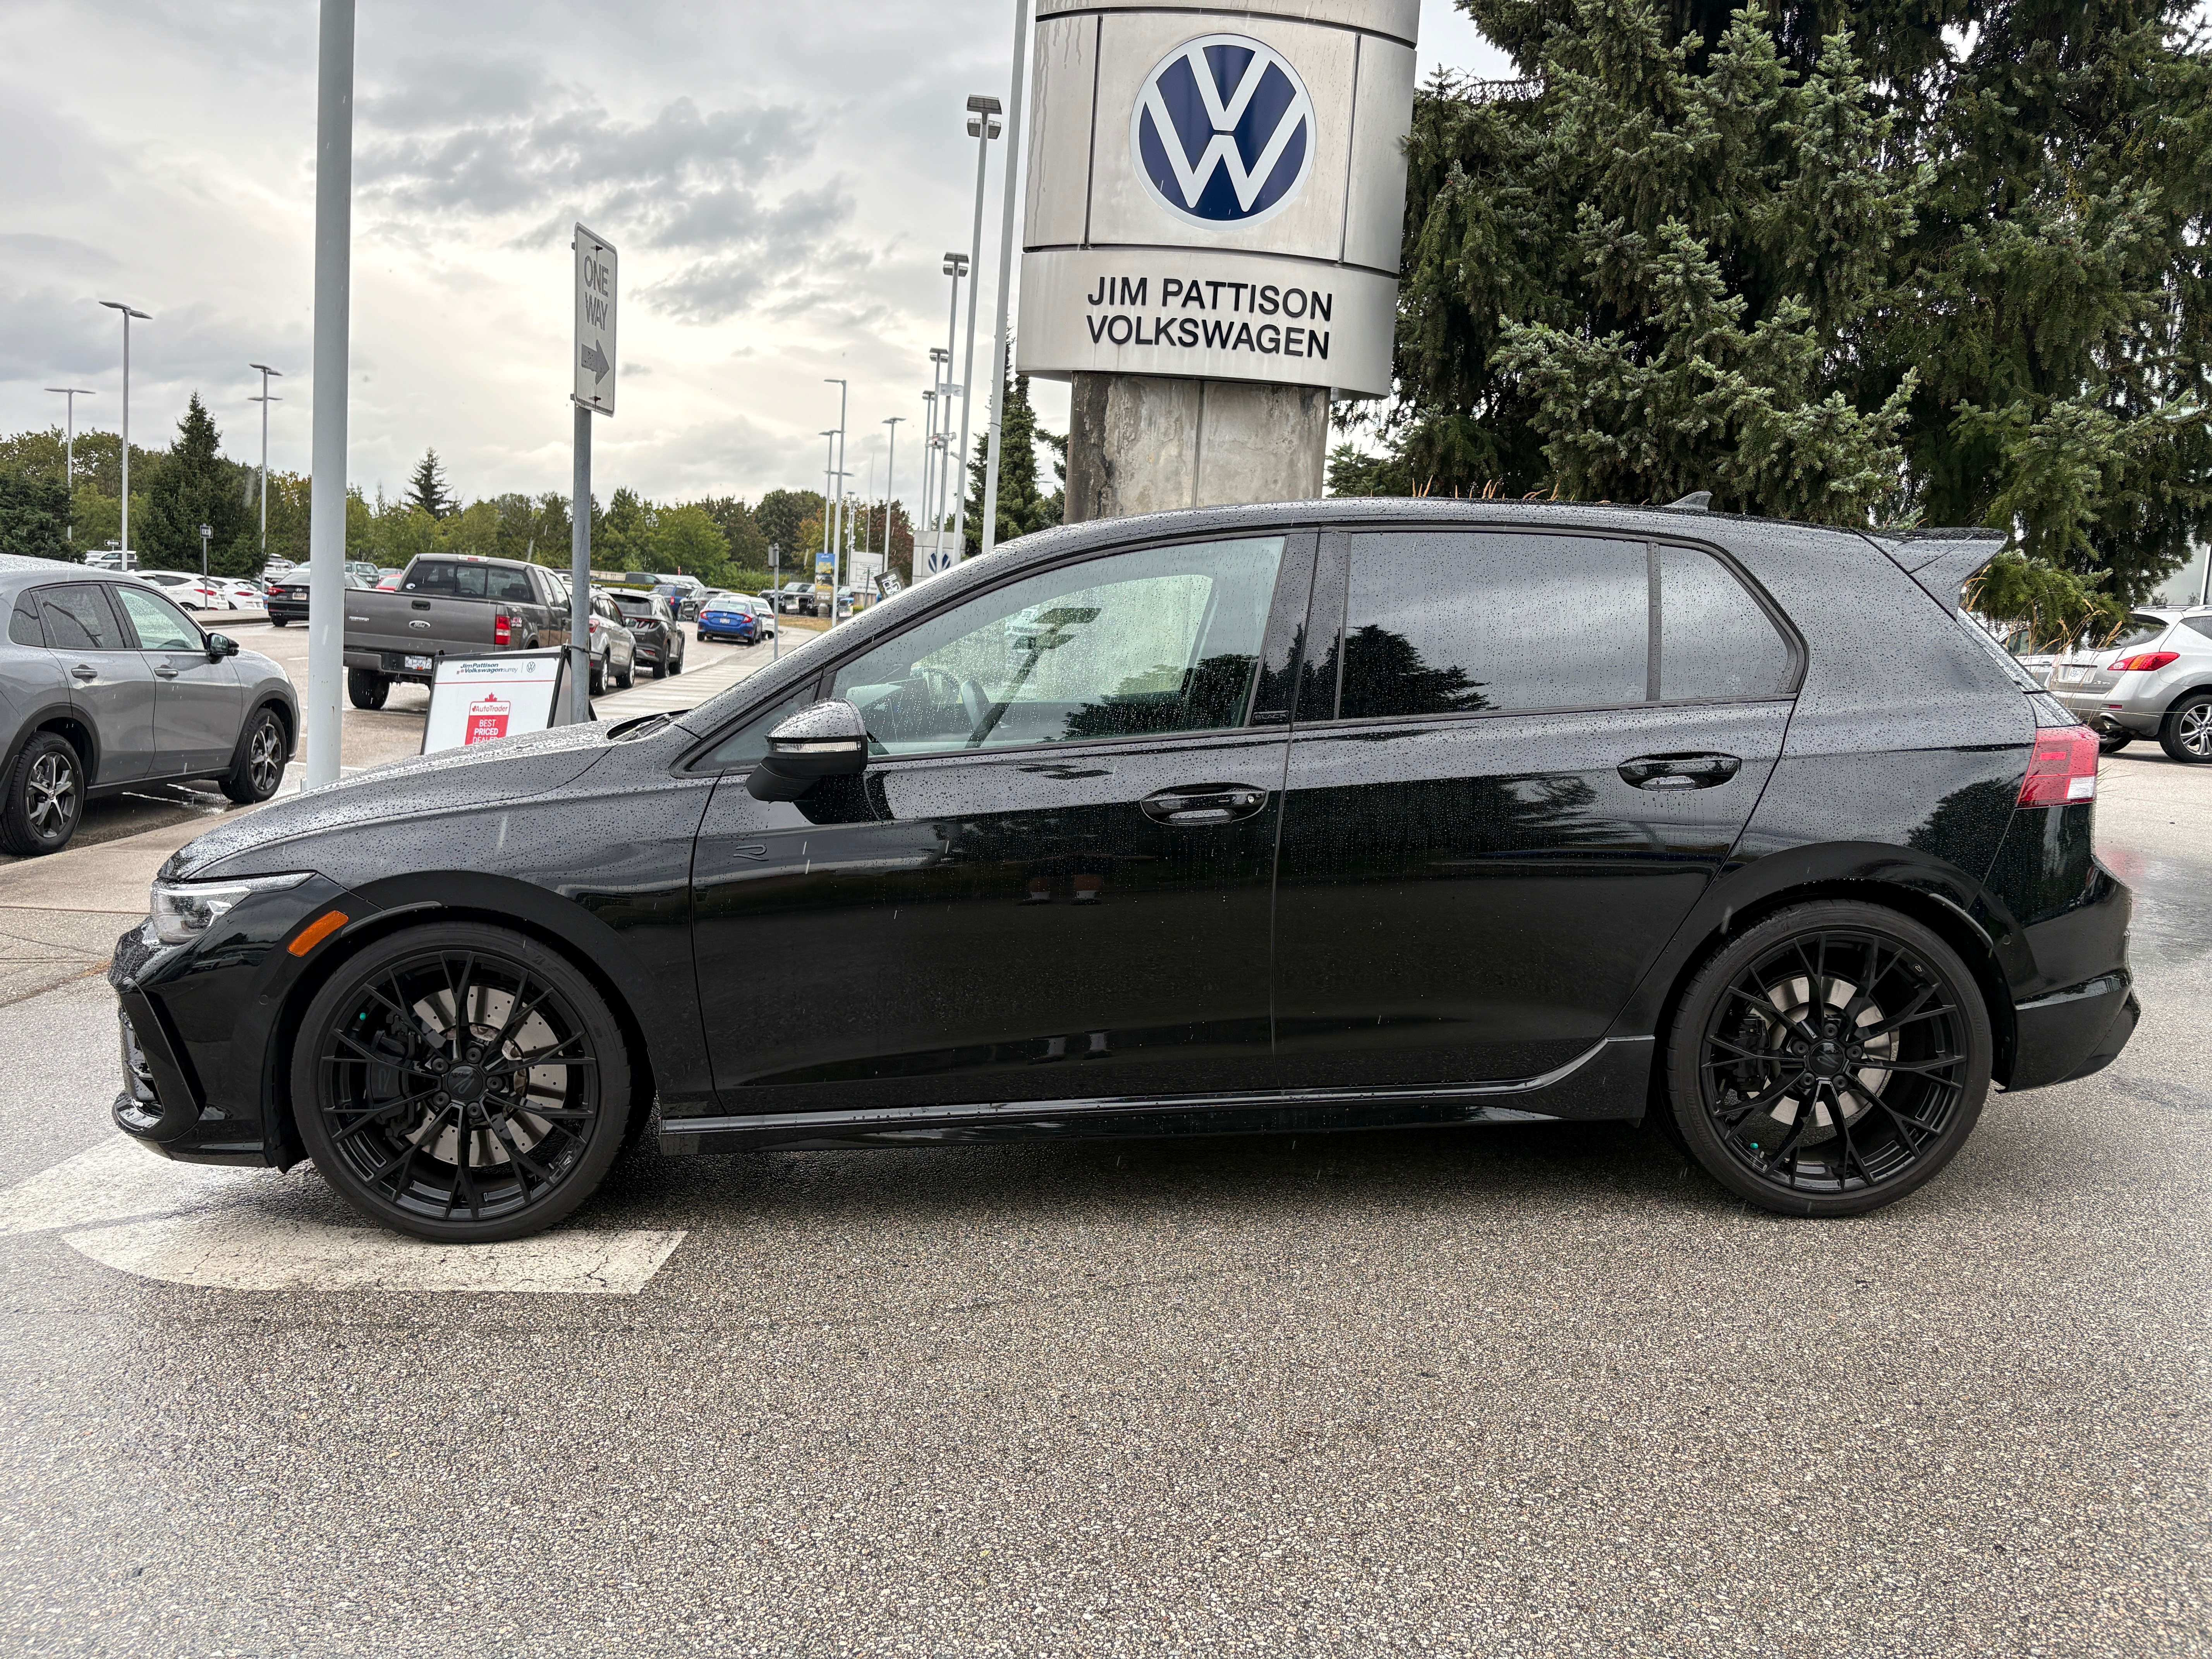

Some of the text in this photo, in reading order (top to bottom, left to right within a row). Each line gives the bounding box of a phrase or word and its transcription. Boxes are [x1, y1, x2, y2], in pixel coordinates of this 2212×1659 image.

[584, 255, 609, 297] ONE
[585, 291, 608, 330] WAY
[1087, 276, 1332, 321] JIM PATTISON
[1086, 314, 1329, 359] VOLKSWAGEN
[474, 728, 499, 736] PRICED
